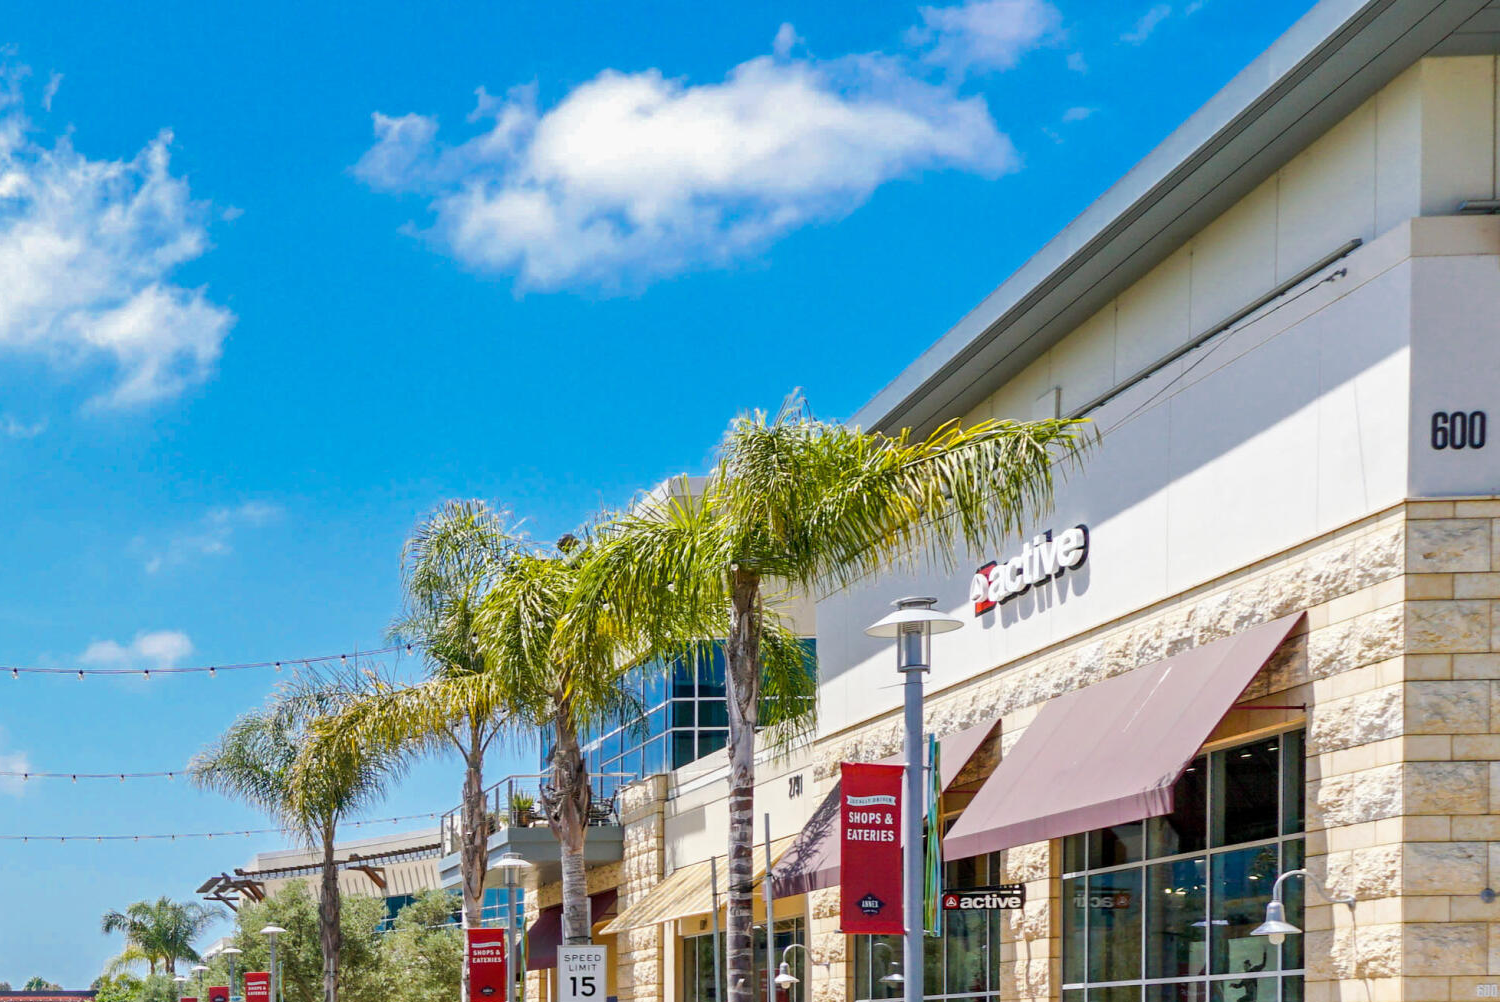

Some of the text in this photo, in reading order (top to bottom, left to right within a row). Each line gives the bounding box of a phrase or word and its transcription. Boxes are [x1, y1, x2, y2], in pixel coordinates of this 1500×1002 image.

[1431, 411, 1486, 450] 600
[988, 526, 1088, 603] active
[848, 811, 894, 825] SHOPS &
[847, 828, 895, 842] EATERIES
[960, 894, 1021, 909] active
[564, 954, 602, 962] SPEED
[568, 964, 597, 972] LIMIT
[569, 976, 596, 997] 15
